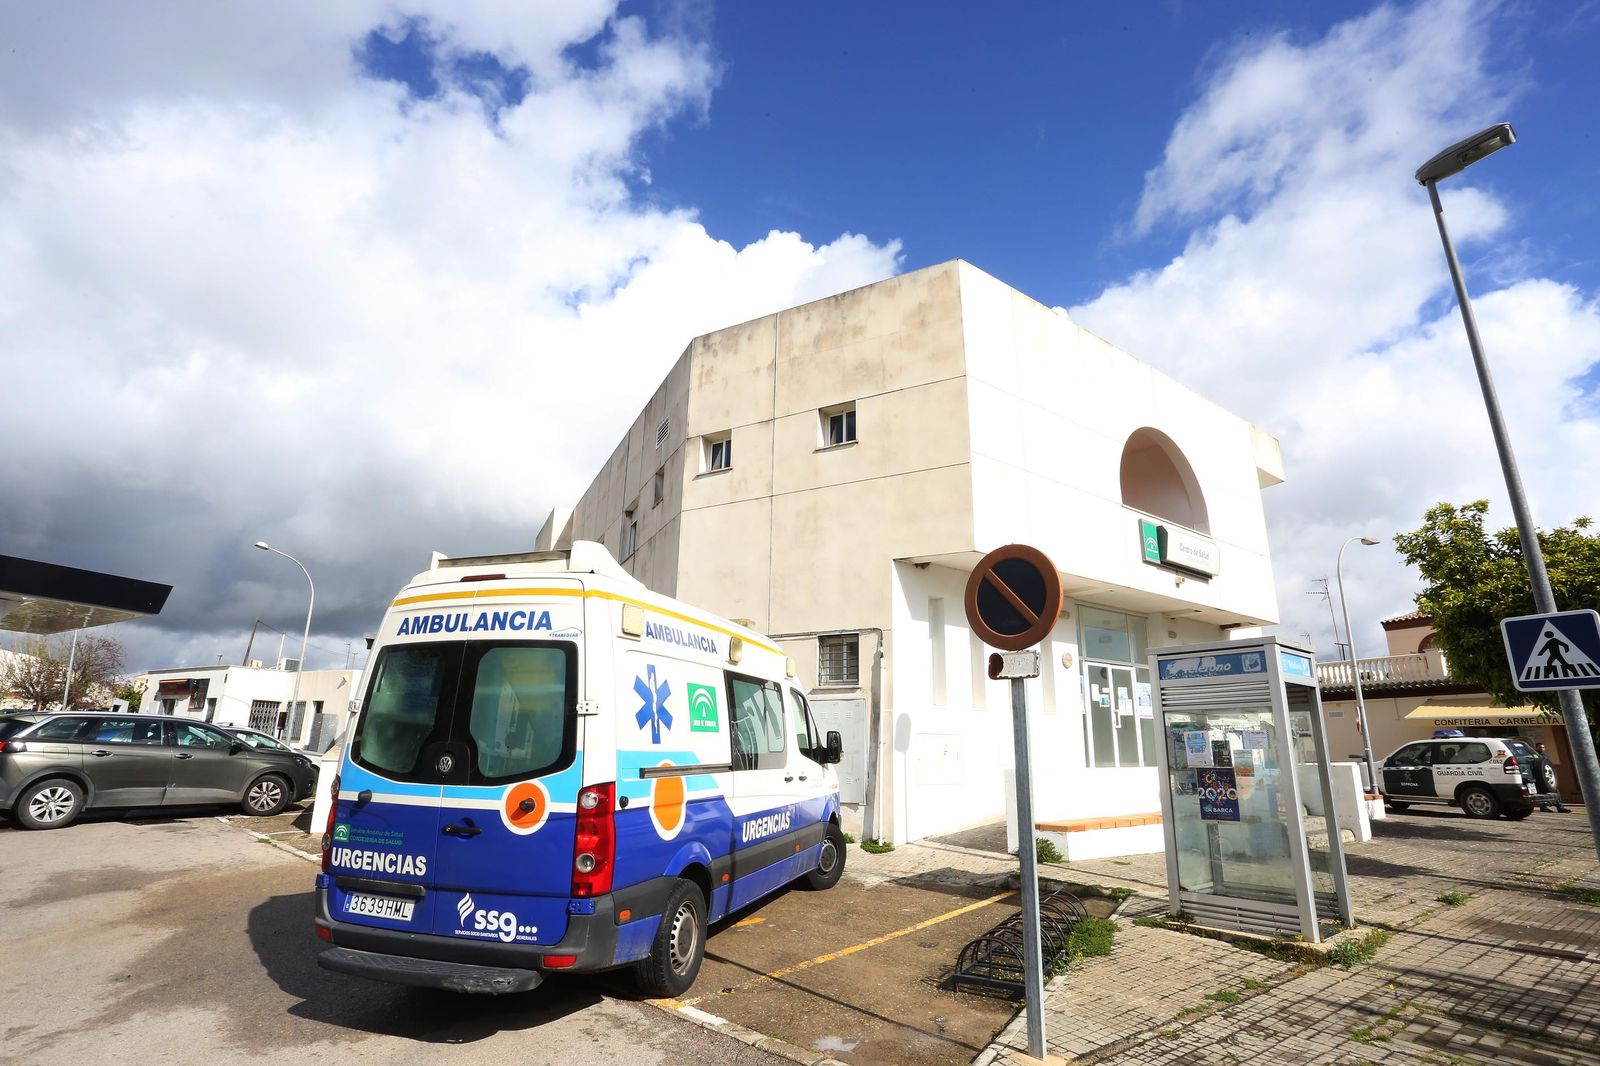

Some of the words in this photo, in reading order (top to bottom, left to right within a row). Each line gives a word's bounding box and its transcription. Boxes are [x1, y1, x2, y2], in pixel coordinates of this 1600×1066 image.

[1198, 548, 1210, 560] Salud
[396, 610, 553, 636] AMBULANCIA
[645, 620, 718, 655] AMBULANCIA
[1433, 718, 1492, 727] CONFITERIA
[1499, 716, 1560, 725] CARMELITA
[1197, 787, 1239, 801] 2020
[742, 811, 791, 843] URGENCIAS
[331, 846, 427, 877] URGENCIAS
